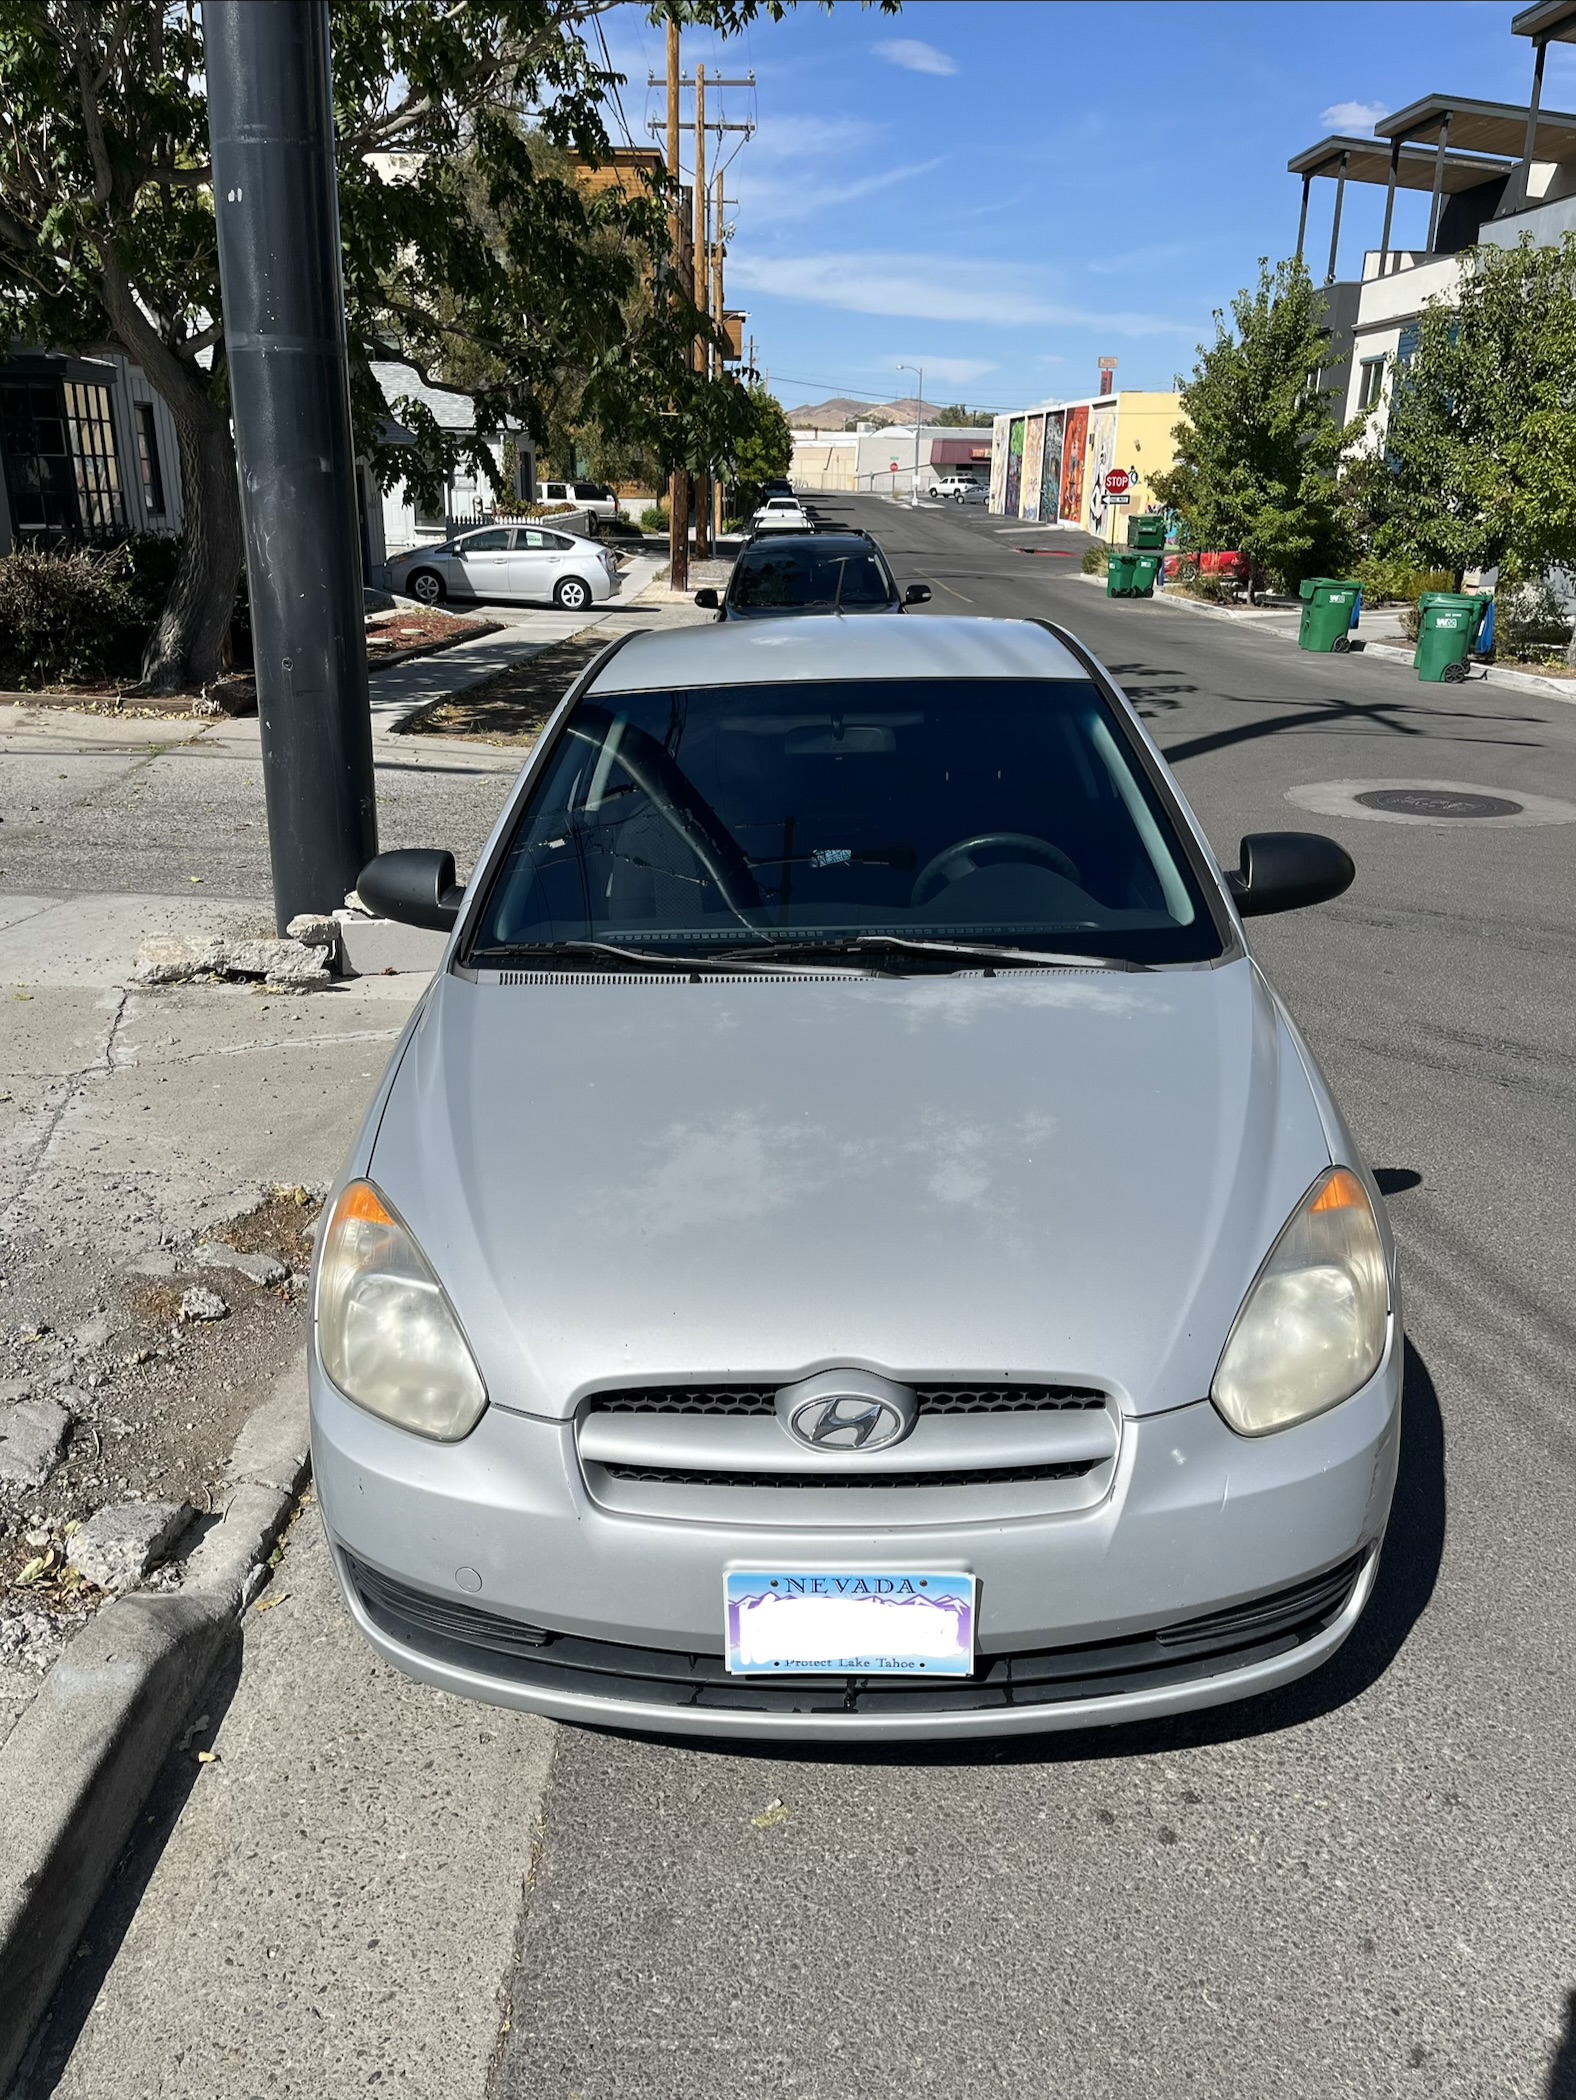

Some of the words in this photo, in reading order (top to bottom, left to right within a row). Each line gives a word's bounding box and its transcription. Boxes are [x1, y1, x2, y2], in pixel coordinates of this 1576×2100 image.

[1106, 476, 1128, 487] STOP
[783, 1577, 917, 1595] NEVADA
[838, 1658, 870, 1668] Lake
[876, 1657, 916, 1669] Tahoe
